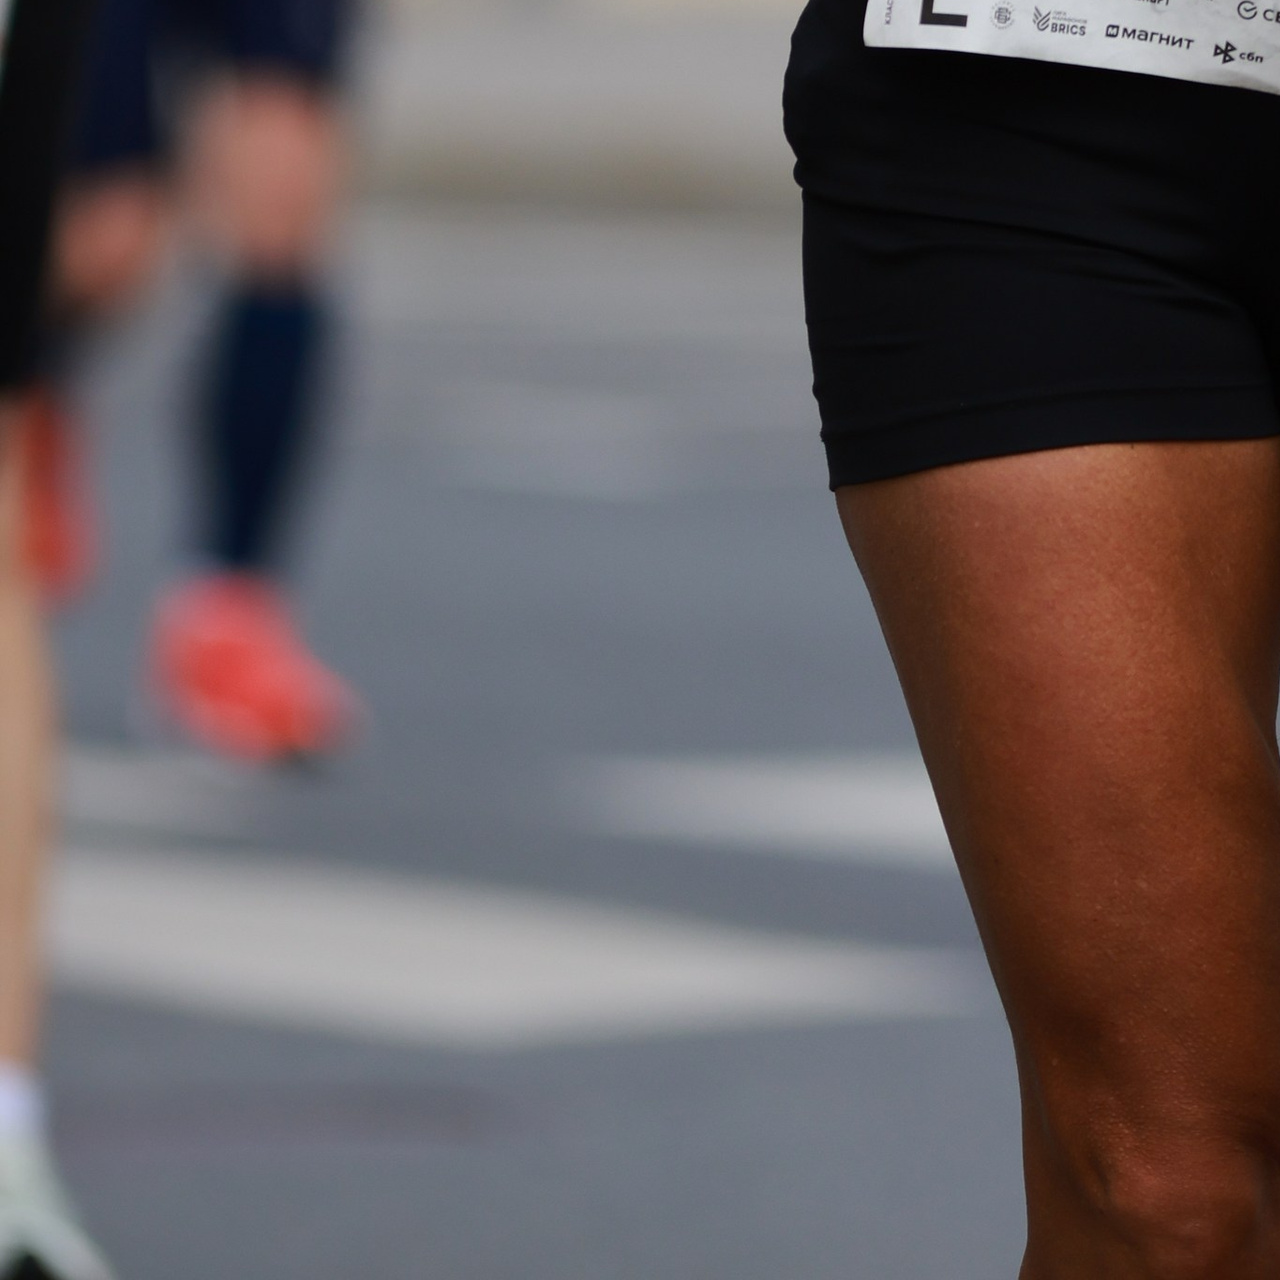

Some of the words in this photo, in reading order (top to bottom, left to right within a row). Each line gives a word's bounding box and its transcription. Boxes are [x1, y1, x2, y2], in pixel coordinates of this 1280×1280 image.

[1050, 23, 1087, 36] BRICS
[1121, 27, 1195, 50] магнит
[1239, 51, 1264, 63] сбп
